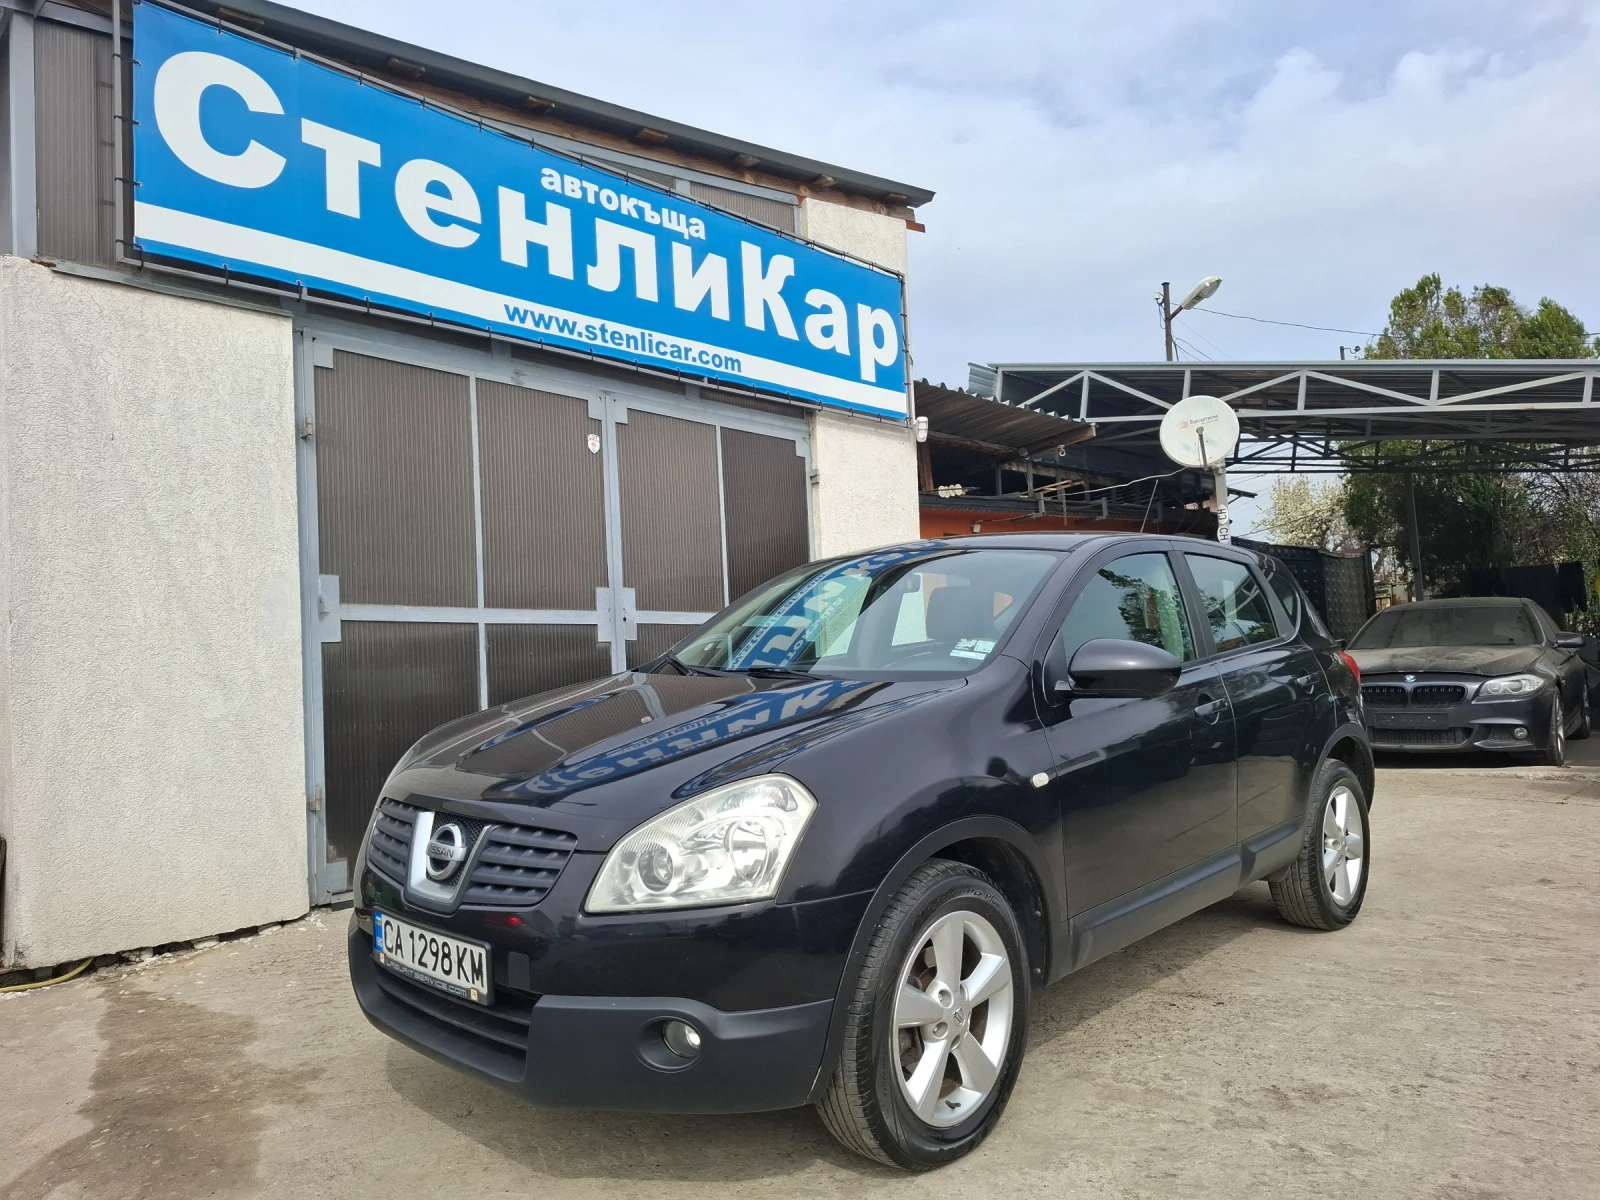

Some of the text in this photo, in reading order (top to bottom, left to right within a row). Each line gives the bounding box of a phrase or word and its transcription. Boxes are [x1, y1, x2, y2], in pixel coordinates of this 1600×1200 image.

[152, 50, 900, 384] СтенлиКар
[540, 167, 707, 241] автокъща
[503, 303, 743, 375] www.stenlicar.com
